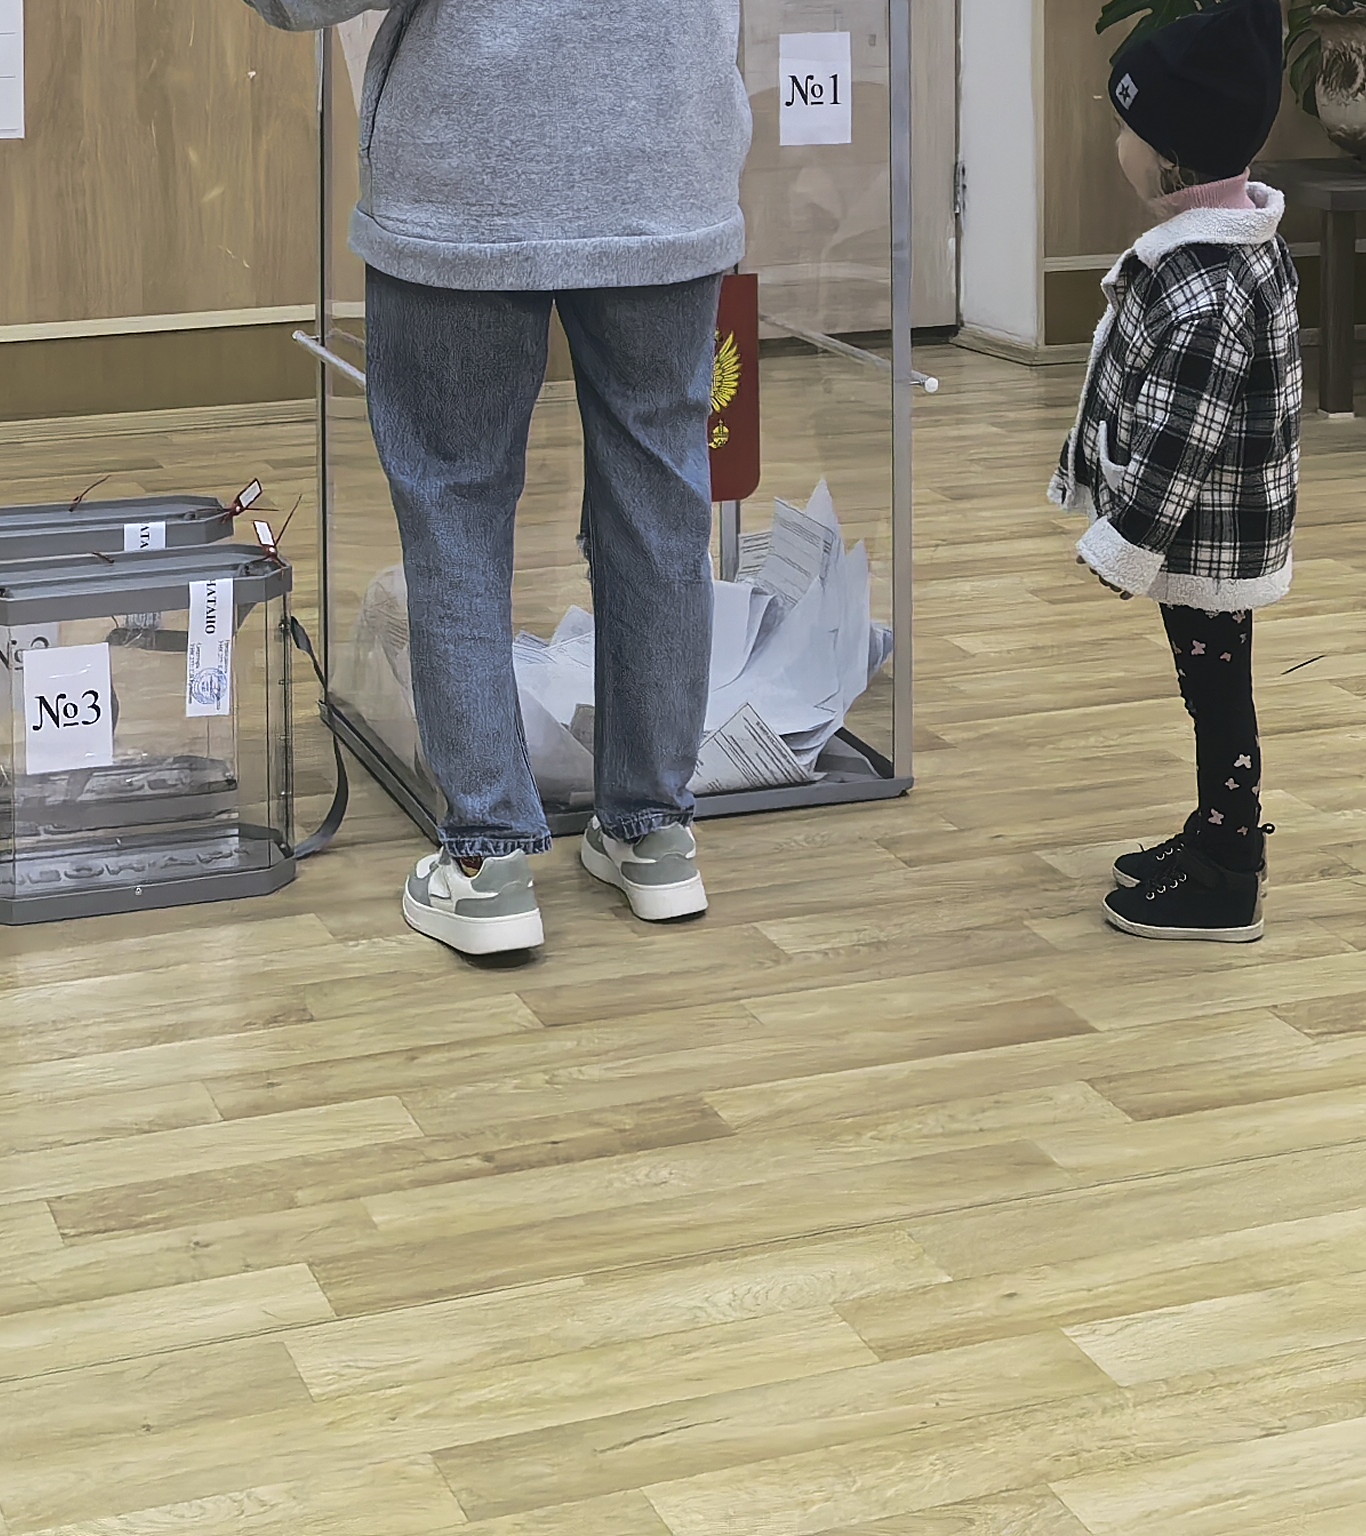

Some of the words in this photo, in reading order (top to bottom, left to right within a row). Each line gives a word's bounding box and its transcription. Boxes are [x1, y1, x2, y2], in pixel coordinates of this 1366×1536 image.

[785, 74, 841, 107] №1
[141, 524, 149, 548] АТА
[32, 690, 101, 731] №3
